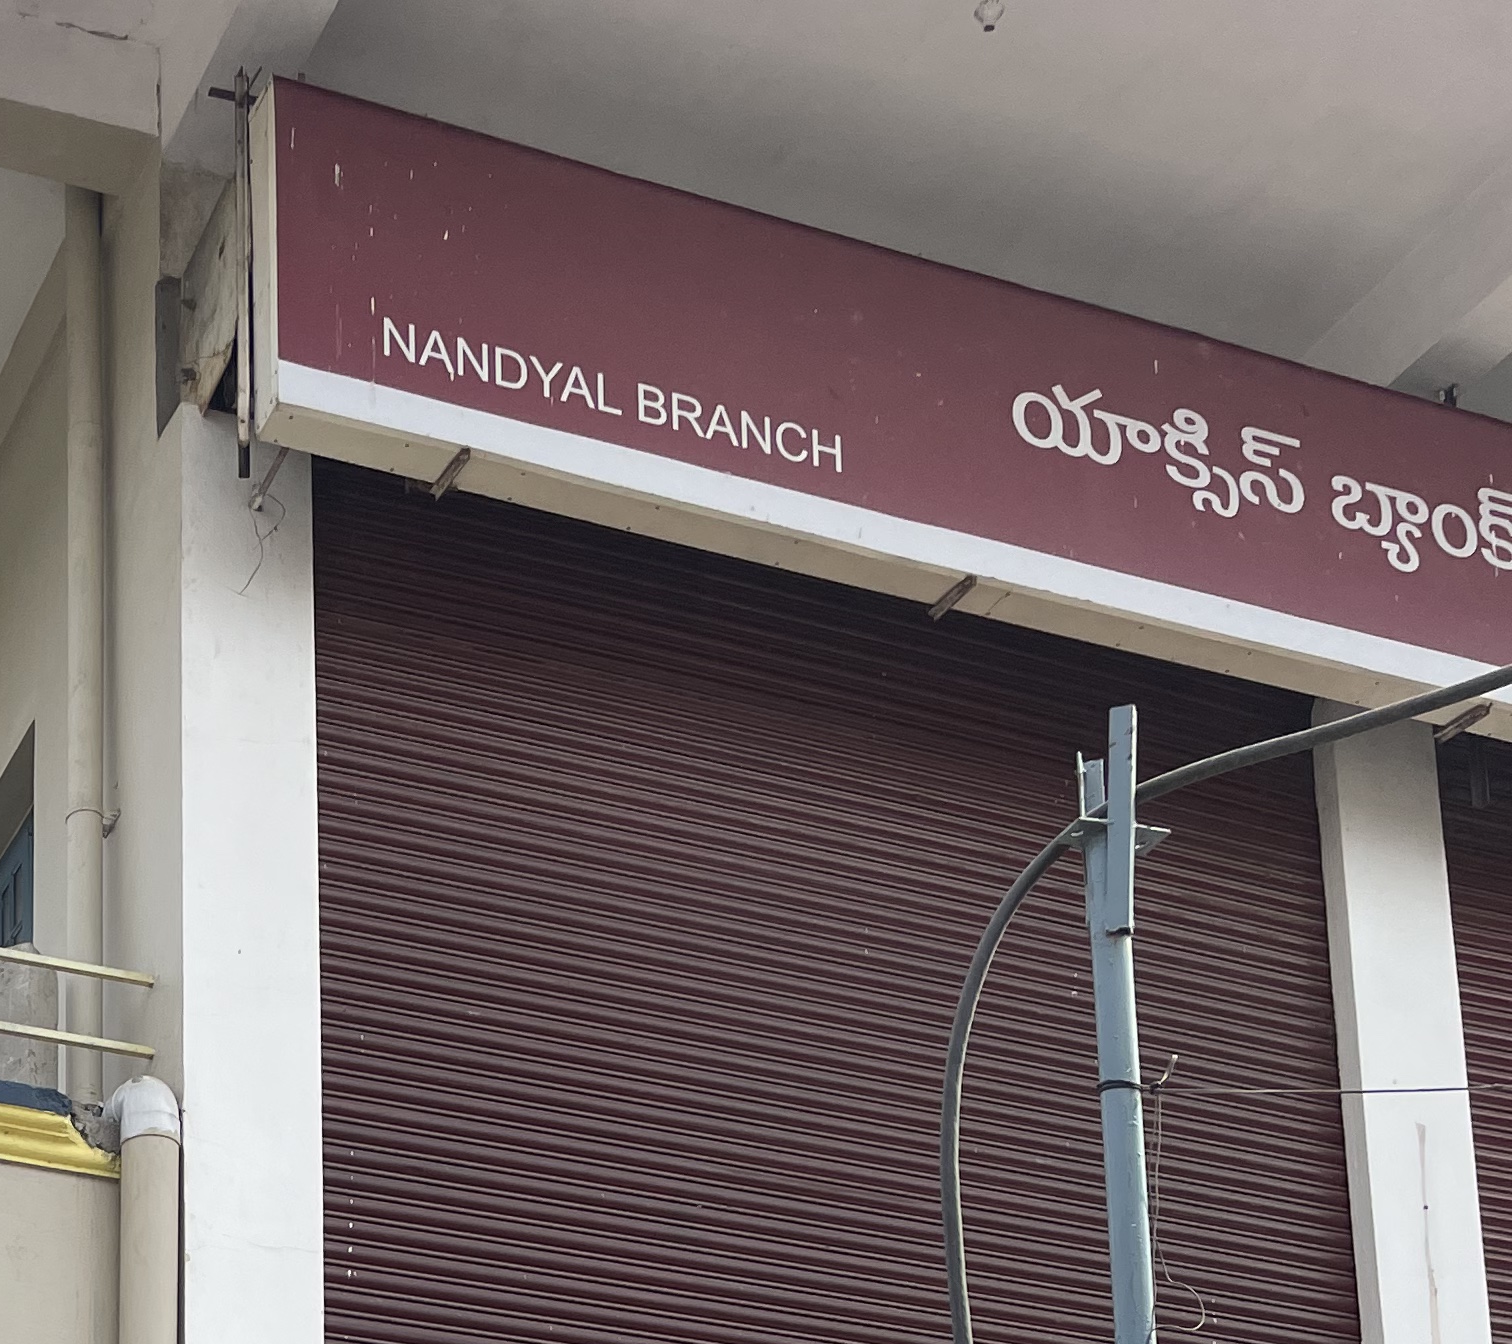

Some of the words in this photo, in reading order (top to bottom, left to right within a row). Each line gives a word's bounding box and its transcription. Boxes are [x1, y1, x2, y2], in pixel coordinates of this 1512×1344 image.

[382, 316, 623, 417] NANDYAL
[637, 382, 843, 473] BRANCH
[1012, 384, 1305, 518] యాక్సిస్
